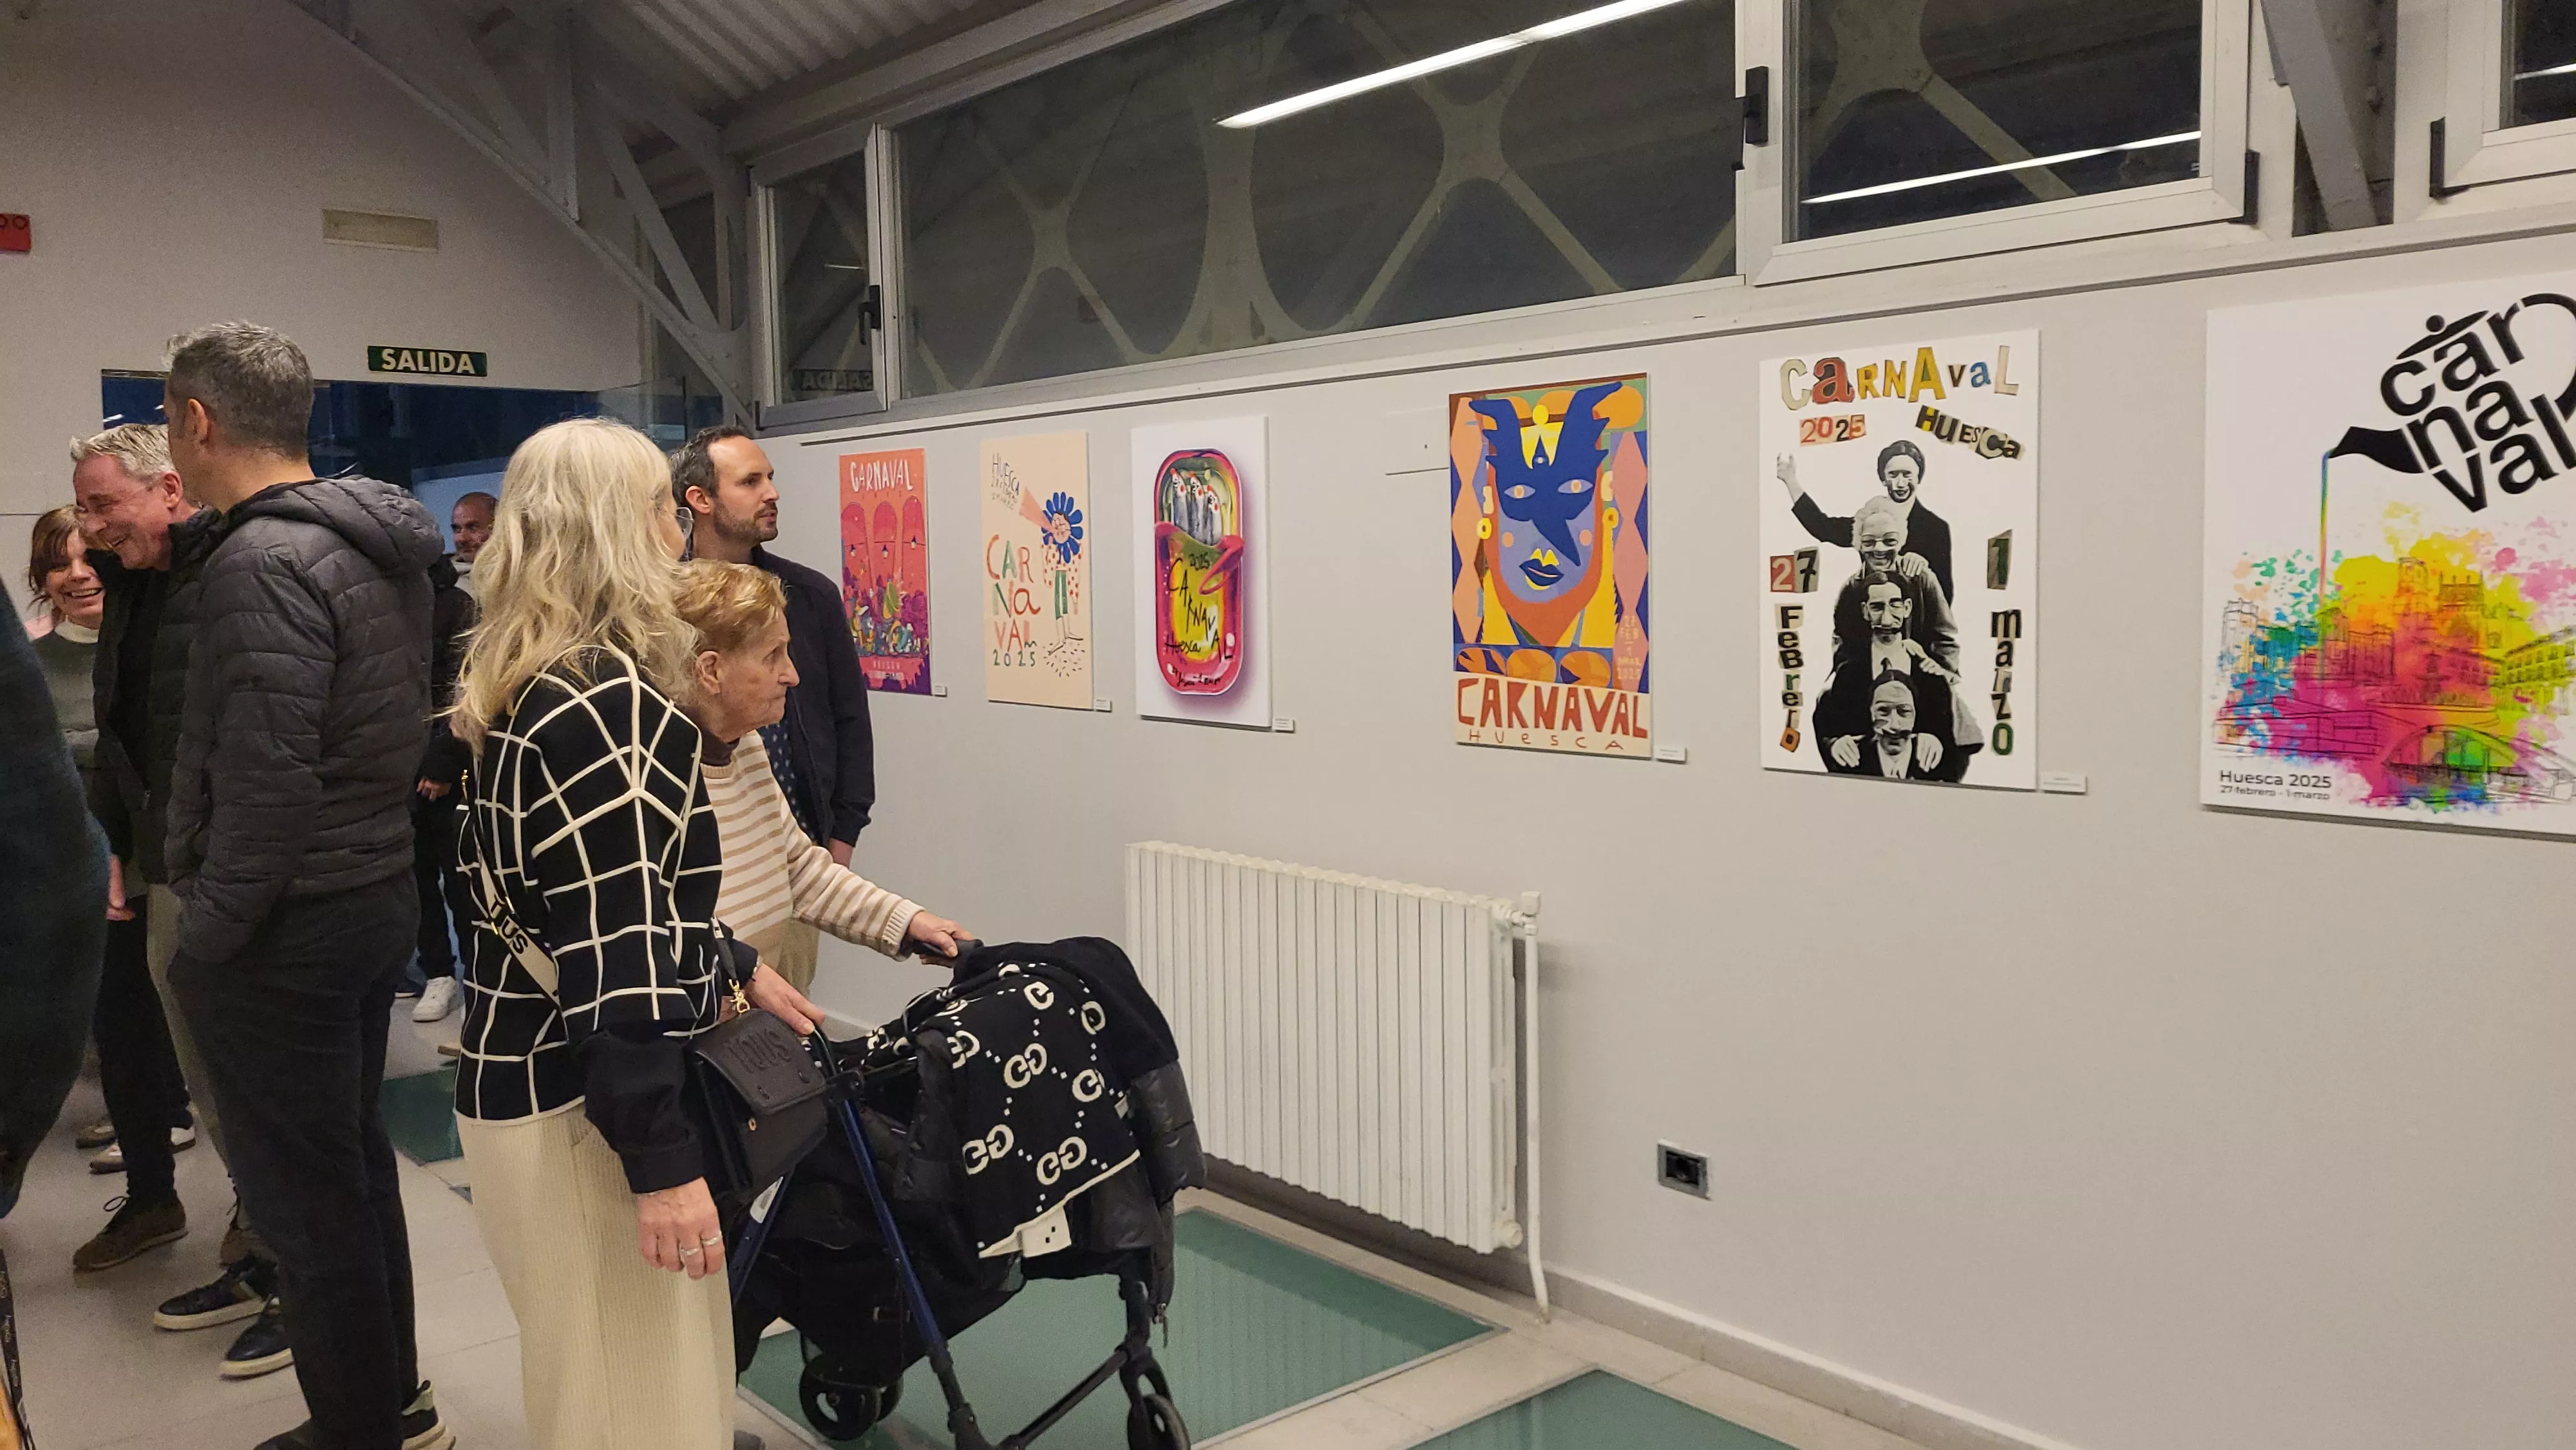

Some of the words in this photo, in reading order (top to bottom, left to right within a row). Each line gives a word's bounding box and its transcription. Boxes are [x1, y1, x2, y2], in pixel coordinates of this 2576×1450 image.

[382, 348, 476, 374] SALIDA
[1800, 414, 1866, 446] 2025
[987, 534, 1034, 583] CAR
[1771, 547, 1819, 592] 27
[1988, 536, 2011, 588] 1
[993, 649, 1036, 667] 2025
[1458, 676, 1649, 739] CARNAVAL
[2221, 770, 2283, 786] Huesca
[2289, 774, 2332, 788] 2025
[2236, 786, 2277, 796] febrero
[2293, 791, 2331, 800] marzo
[491, 894, 528, 954] TUS
